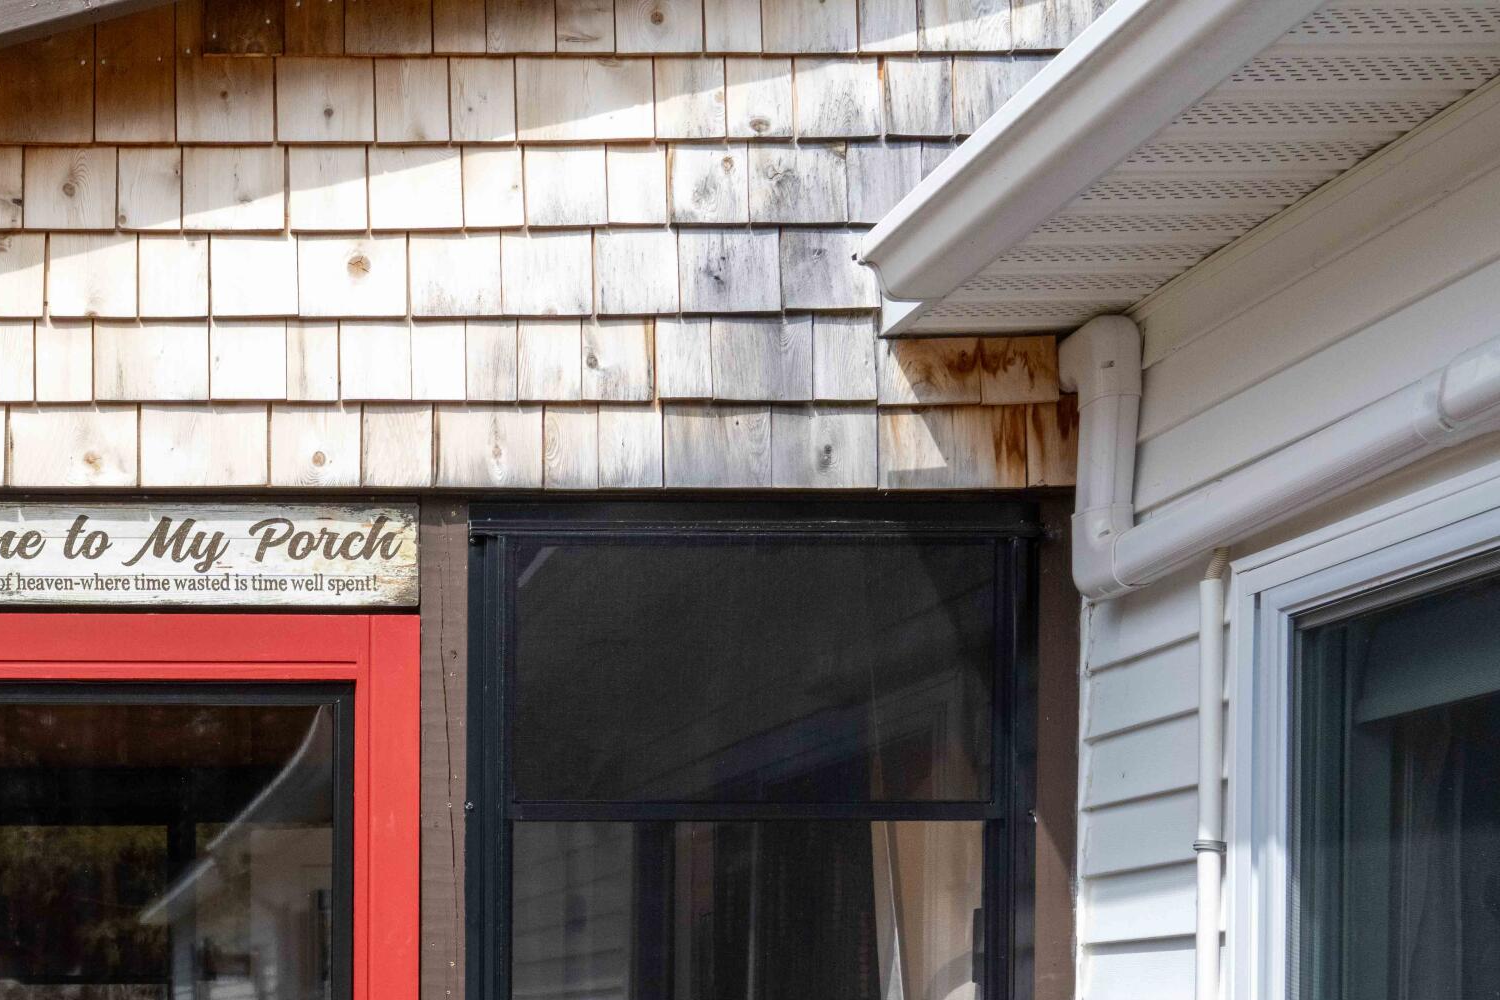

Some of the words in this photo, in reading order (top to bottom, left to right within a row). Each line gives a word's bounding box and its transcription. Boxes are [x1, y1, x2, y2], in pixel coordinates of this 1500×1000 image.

[63, 514, 113, 560] to
[121, 516, 230, 573] My
[249, 515, 403, 562] Porch
[16, 572, 130, 591] heaven-where
[134, 573, 171, 591] time
[174, 573, 230, 591] wasted
[234, 573, 247, 591] is
[251, 574, 287, 591] time
[290, 573, 323, 591] well
[327, 575, 378, 595] spent!
